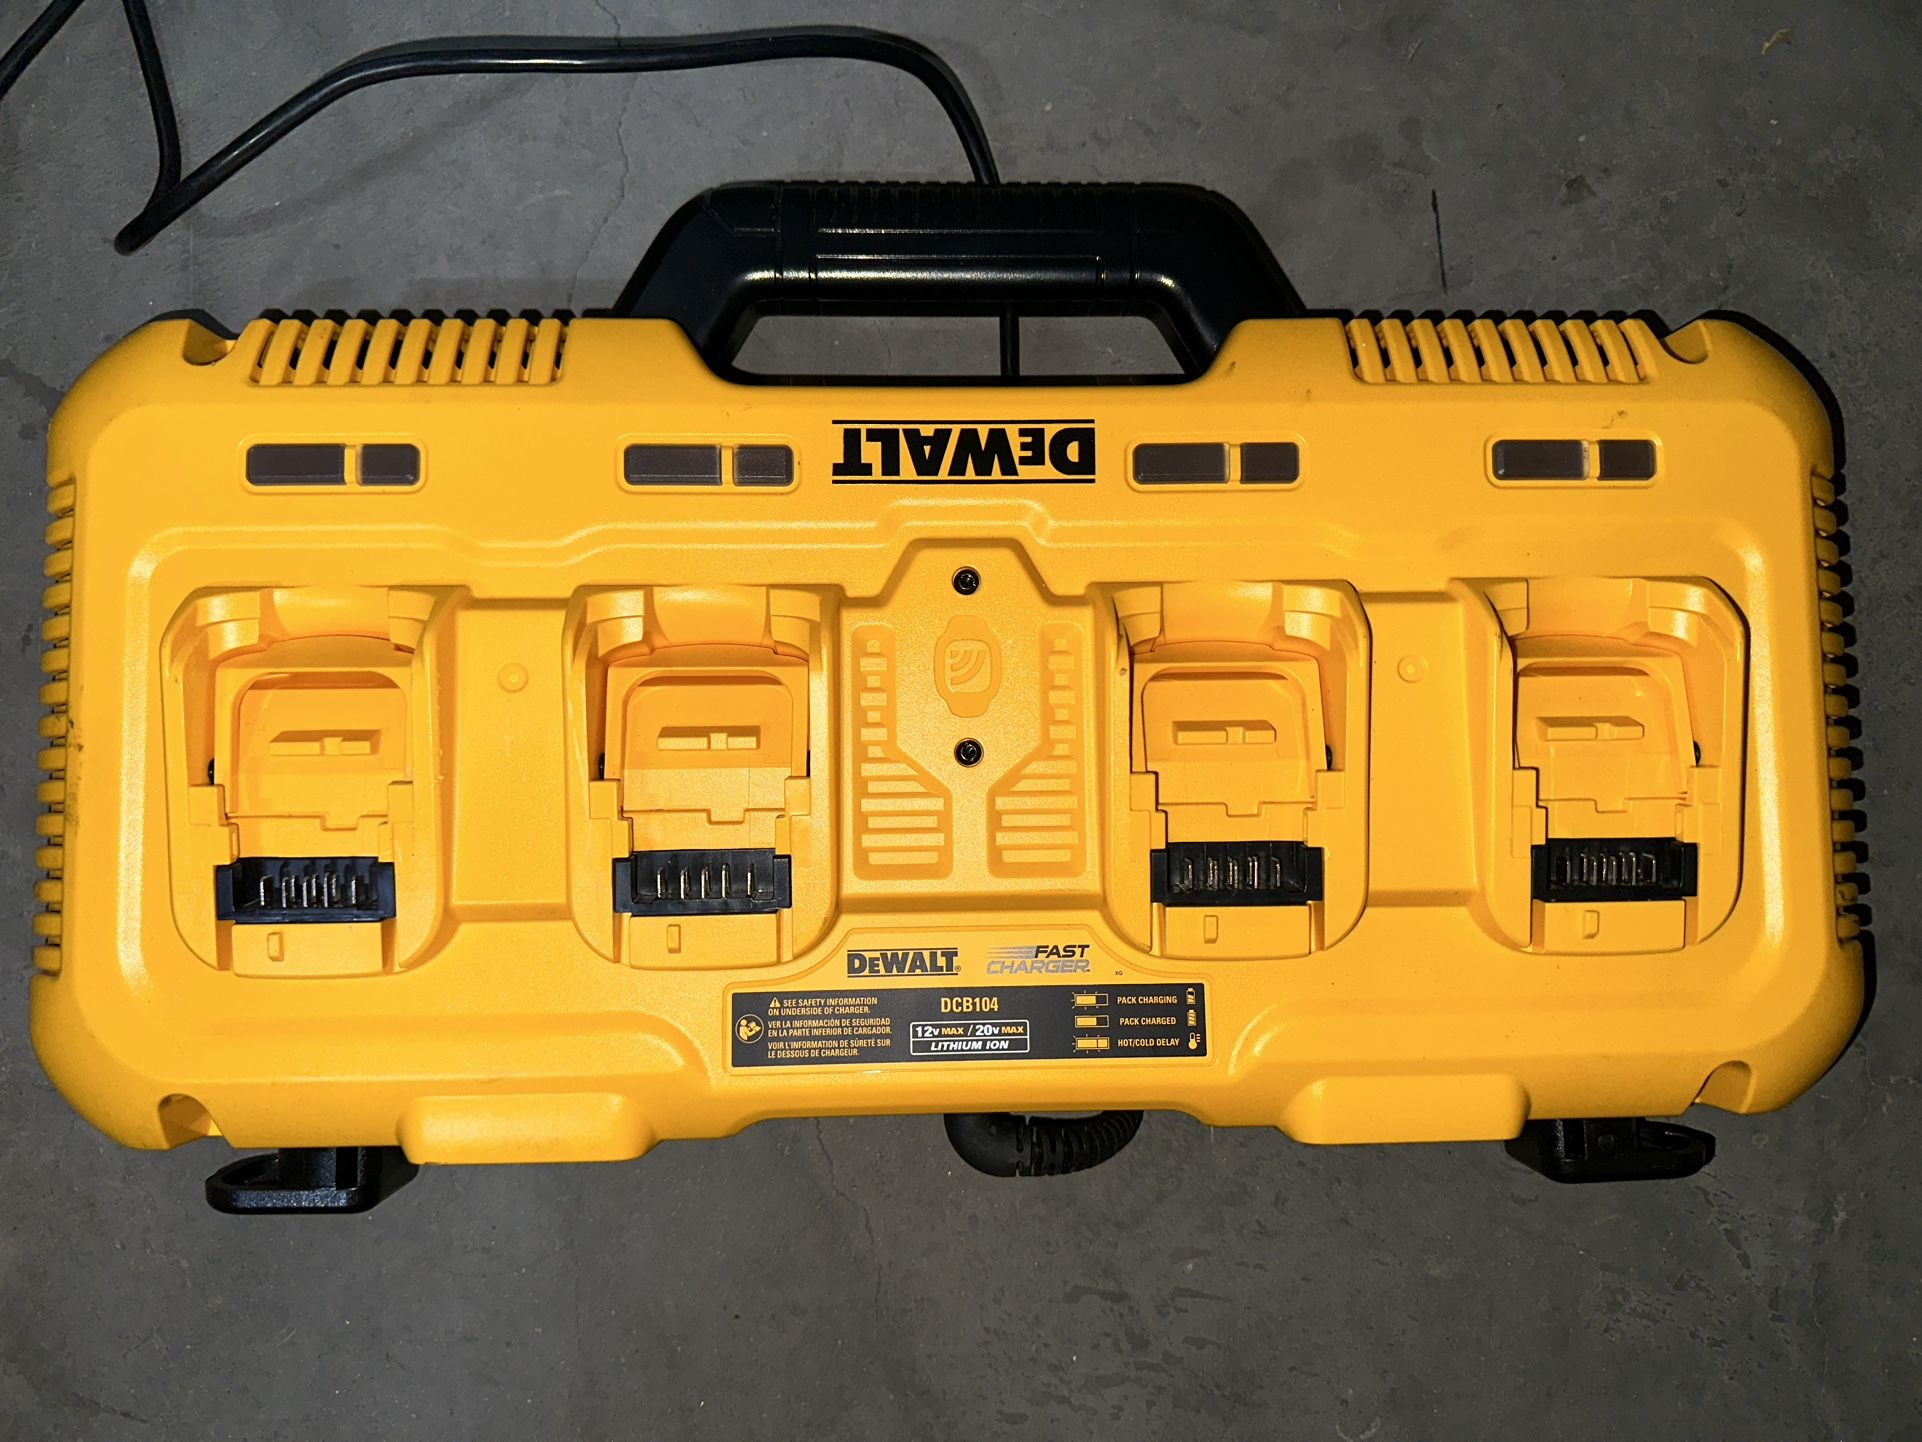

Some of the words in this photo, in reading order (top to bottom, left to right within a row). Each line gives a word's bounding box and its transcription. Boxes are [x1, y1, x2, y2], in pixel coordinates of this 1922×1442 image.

[832, 427, 1095, 476] DEWALT
[1034, 944, 1090, 959] FAST
[986, 959, 1088, 975] CHARGER
[783, 998, 796, 1007] SEE
[798, 998, 825, 1007] SAFETY
[826, 997, 878, 1006] INFORMATION
[941, 996, 999, 1013] DCB104
[1117, 996, 1137, 1004] PACK
[1138, 995, 1177, 1004] CHARGING
[768, 1008, 779, 1016] ON
[781, 1007, 822, 1015] UNDERSIDE
[824, 1006, 833, 1014] OF
[834, 1005, 870, 1014] CHARGER.
[767, 1020, 781, 1028] VER
[782, 1020, 791, 1028] LA
[792, 1018, 841, 1028] INFORMACIÓN
[842, 1018, 851, 1027] DE
[852, 1017, 891, 1026] SEGURIDAD
[1120, 1017, 1139, 1025] PACK
[1140, 1017, 1176, 1025] CHARGED
[768, 1029, 778, 1037] EN
[779, 1029, 788, 1037] LA
[788, 1028, 810, 1036] PARTE
[811, 1027, 843, 1036] INFERIOR
[844, 1027, 852, 1035] DE
[853, 1026, 892, 1035] CARGADOR.
[941, 1027, 964, 1035] MAX
[967, 1025, 973, 1036] /
[1001, 1026, 1024, 1034] MAX
[767, 1041, 784, 1050] VOIR
[785, 1040, 839, 1049] L'INFORMATION
[840, 1039, 849, 1048] DE
[850, 1038, 875, 1048] SÛRETÉ
[877, 1039, 891, 1047] SUR
[930, 1040, 983, 1051] LITHIUM
[985, 1040, 1010, 1050] ION
[1118, 1038, 1155, 1047] HOT/COLD
[1156, 1038, 1180, 1046] DELAY
[777, 1049, 808, 1058] DESSOUS
[811, 1049, 819, 1057] DE
[821, 1048, 859, 1057] CHARGEUR.
